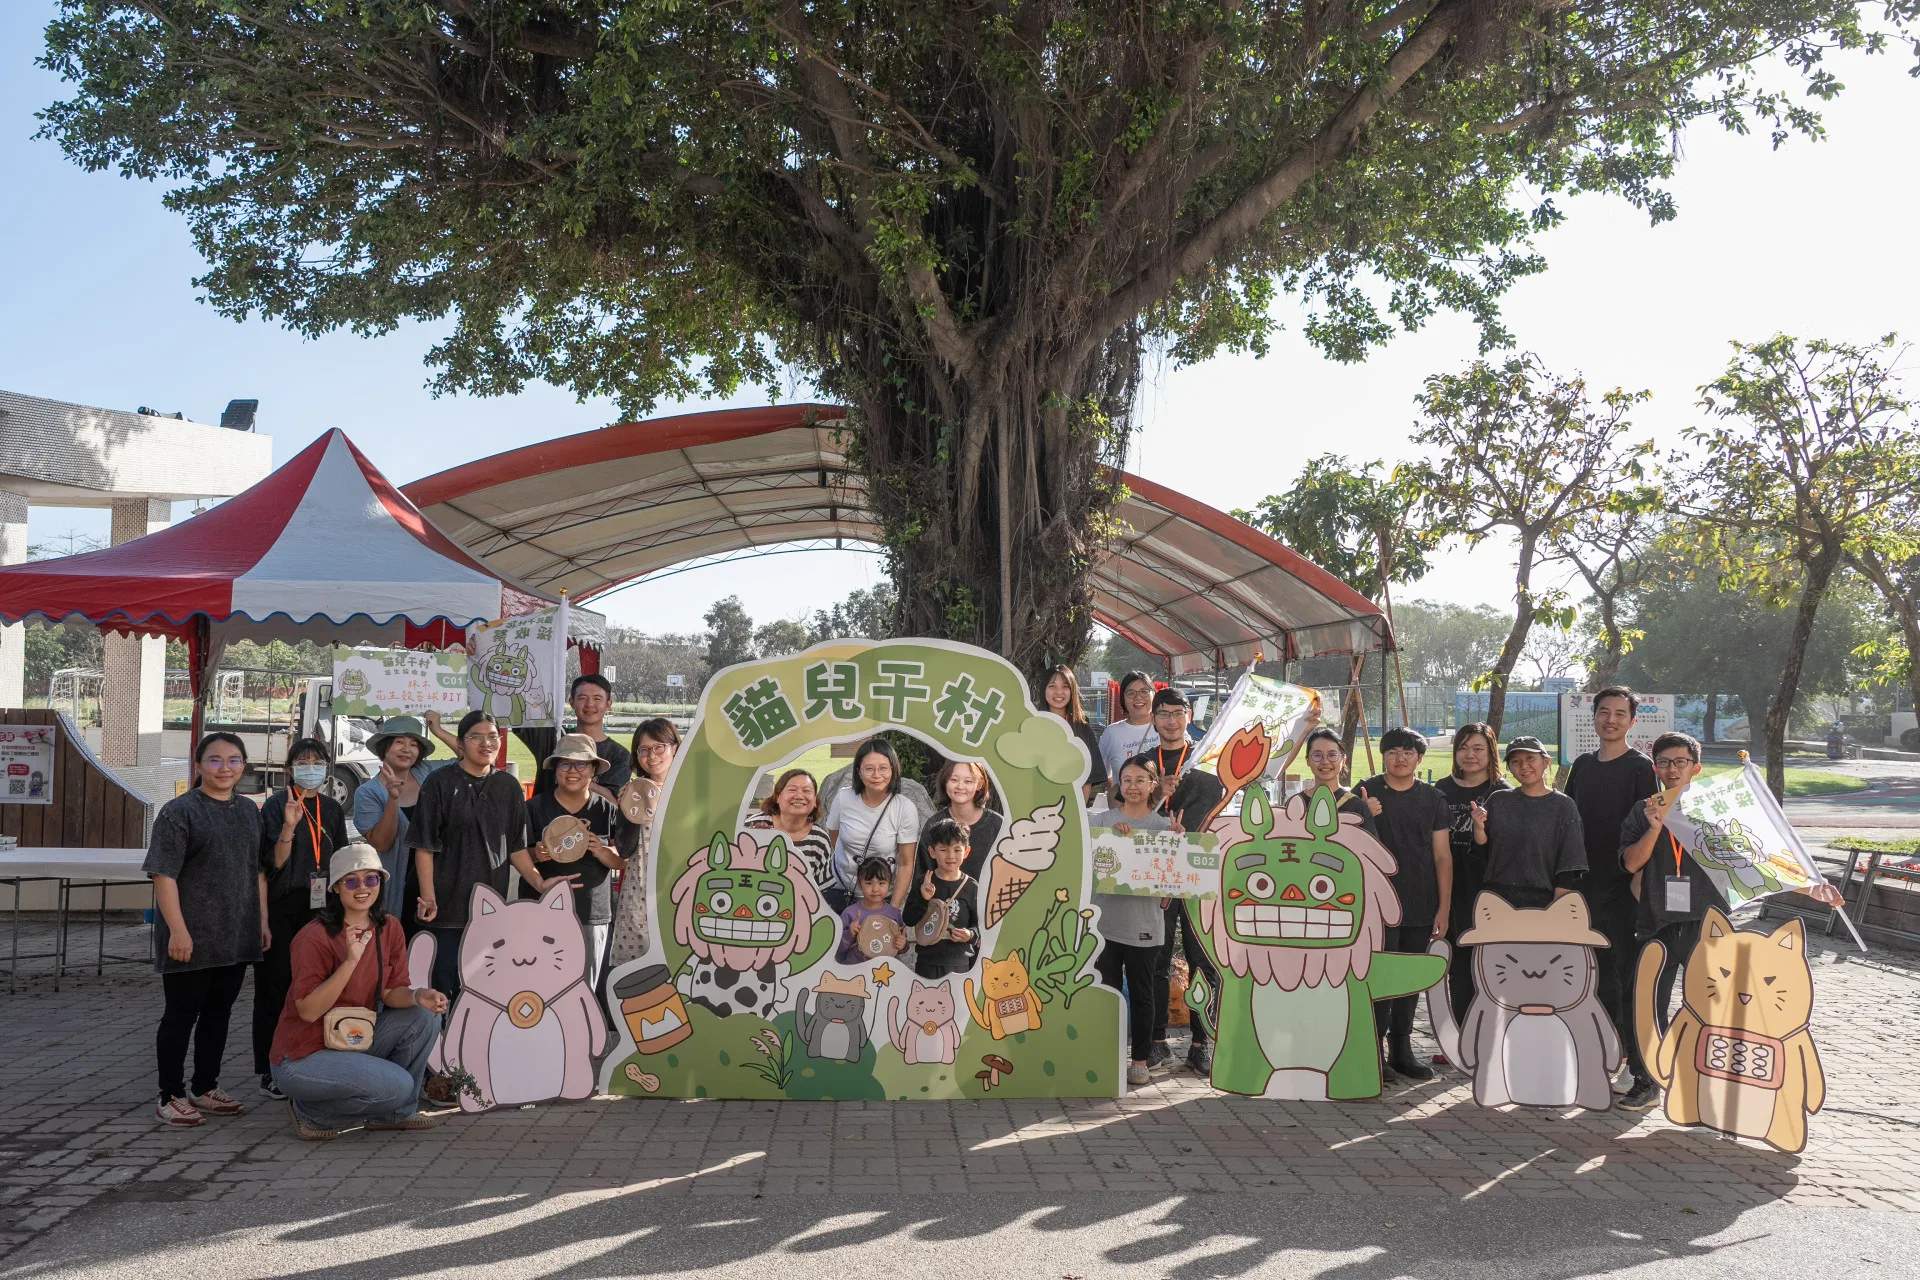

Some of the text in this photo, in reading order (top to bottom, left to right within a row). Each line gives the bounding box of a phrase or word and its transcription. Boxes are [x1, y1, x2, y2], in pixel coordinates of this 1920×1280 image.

[382, 656, 431, 669] 貓兒干村
[442, 676, 463, 685] C01
[442, 692, 462, 702] DIY
[721, 661, 1004, 748] 貓兒干村
[1133, 835, 1181, 848] 貓兒干村
[1278, 843, 1300, 863] 王
[1193, 855, 1215, 866] B02
[739, 874, 753, 888] 王
